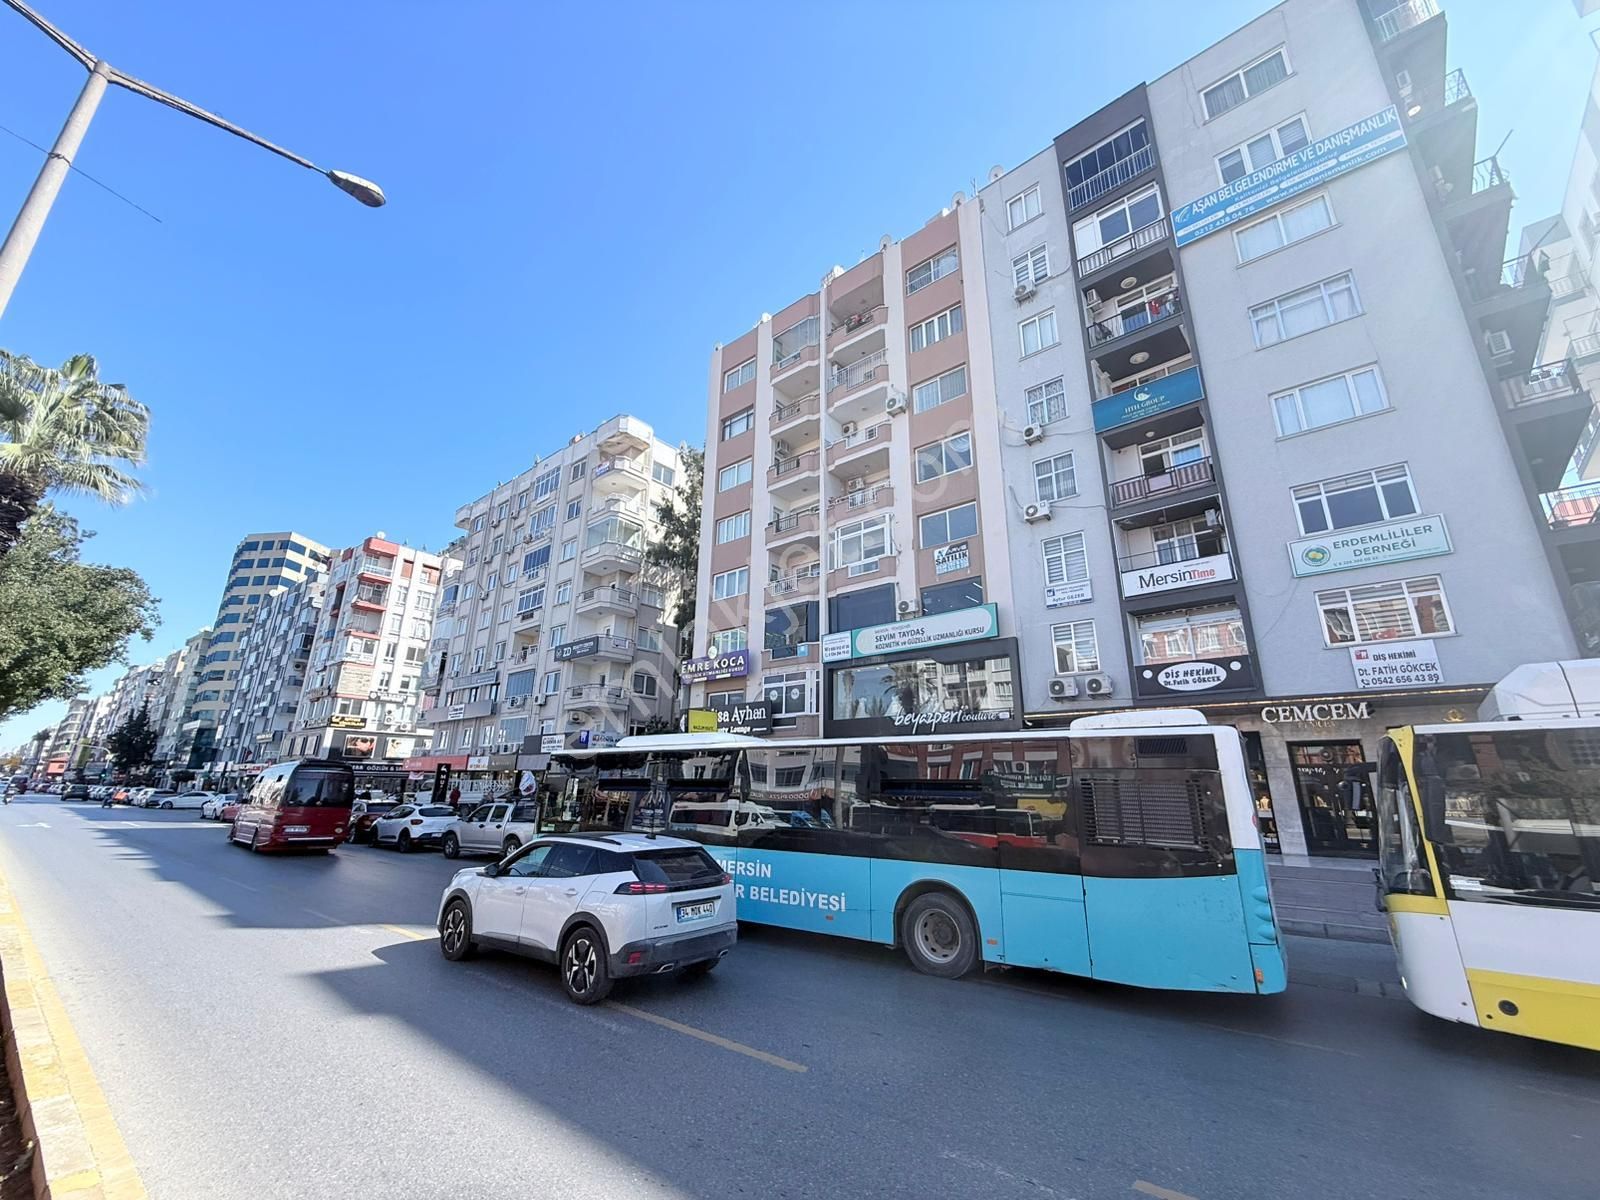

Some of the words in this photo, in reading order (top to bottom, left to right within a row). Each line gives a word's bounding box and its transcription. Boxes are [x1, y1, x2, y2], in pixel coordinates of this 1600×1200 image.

[1192, 193, 1219, 215] AŞAN
[1299, 146, 1314, 162] VE
[1316, 108, 1397, 156] DANIŞMANLIK
[1194, 222, 1215, 237] 0212
[1232, 210, 1242, 219] 04
[1266, 147, 1387, 204] www.asandanismanlik.com
[1141, 395, 1165, 409] GROUP
[1333, 524, 1433, 550] ERDEMLİLİLER
[1353, 538, 1417, 557] DERNEĞİ
[936, 551, 968, 566] SATILIK
[875, 631, 896, 643] SEVİM
[898, 627, 925, 639] TAYDAŞ
[907, 635, 932, 646] GÜZELLİK
[933, 630, 964, 641] UZMANLIĞI
[964, 626, 985, 636] KURSU
[681, 661, 710, 673] EMRE
[713, 655, 745, 669] KOCA
[1372, 652, 1387, 662] DİŞ
[1387, 649, 1416, 660] HEKİMİ
[1183, 666, 1217, 678] HEKİMİ
[1357, 668, 1371, 677] Dt.
[1371, 663, 1398, 676] FATİH
[1371, 676, 1394, 685] 0542
[1395, 675, 1413, 684] 656
[1414, 673, 1426, 682] 43
[1427, 673, 1440, 682] 89
[731, 705, 767, 725] Ayhan
[1260, 701, 1371, 724] CEMCEM
[717, 858, 771, 879] MERSİN
[749, 886, 847, 912] BELEDİYESİ
[681, 907, 689, 918] 34
